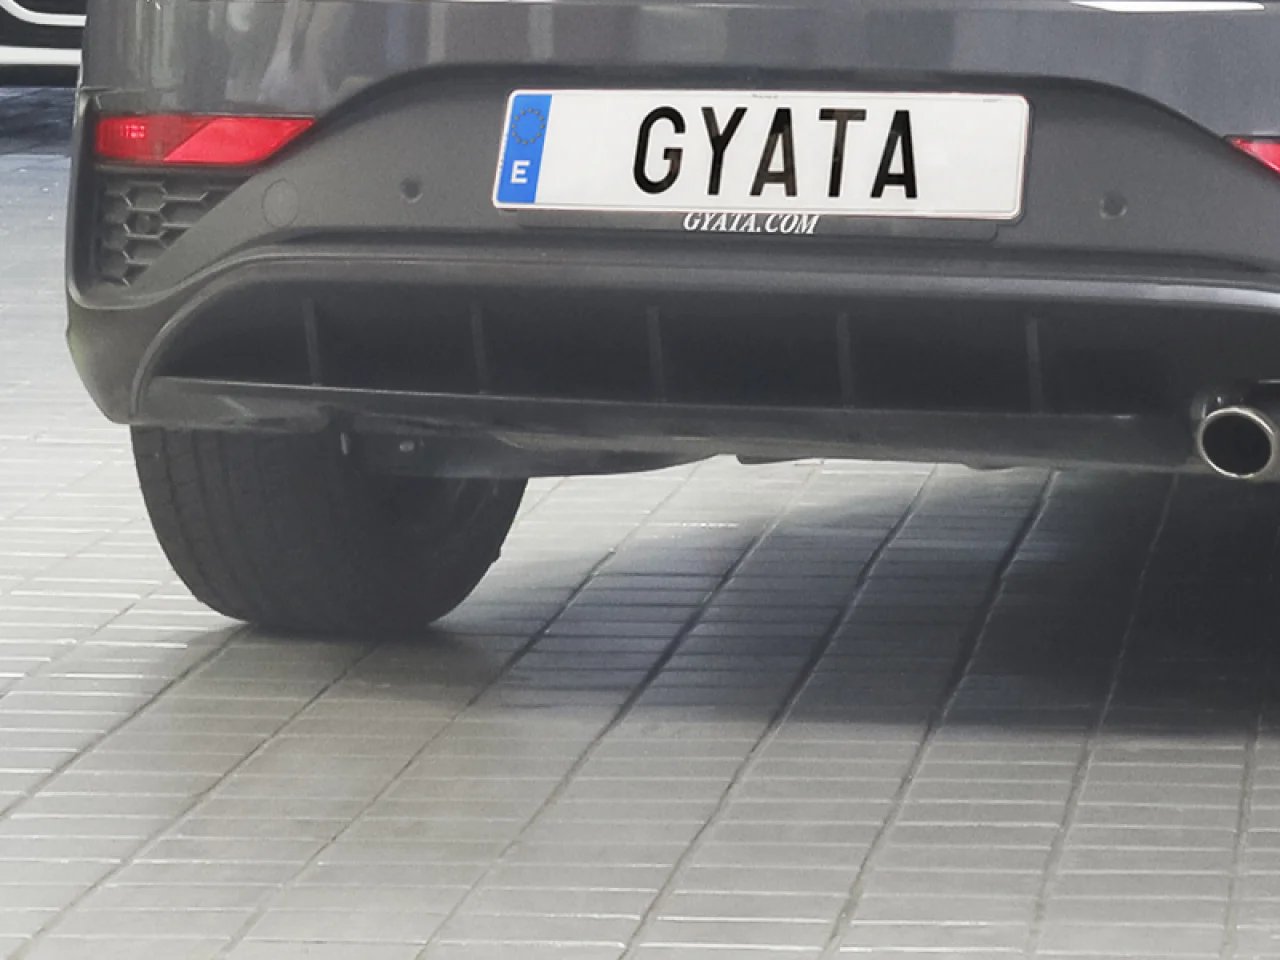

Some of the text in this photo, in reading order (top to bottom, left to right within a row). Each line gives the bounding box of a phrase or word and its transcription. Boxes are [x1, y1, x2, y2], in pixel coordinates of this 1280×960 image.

[633, 106, 918, 199] GYATA
[510, 160, 531, 184] E
[683, 212, 819, 235] GYATA.COM
